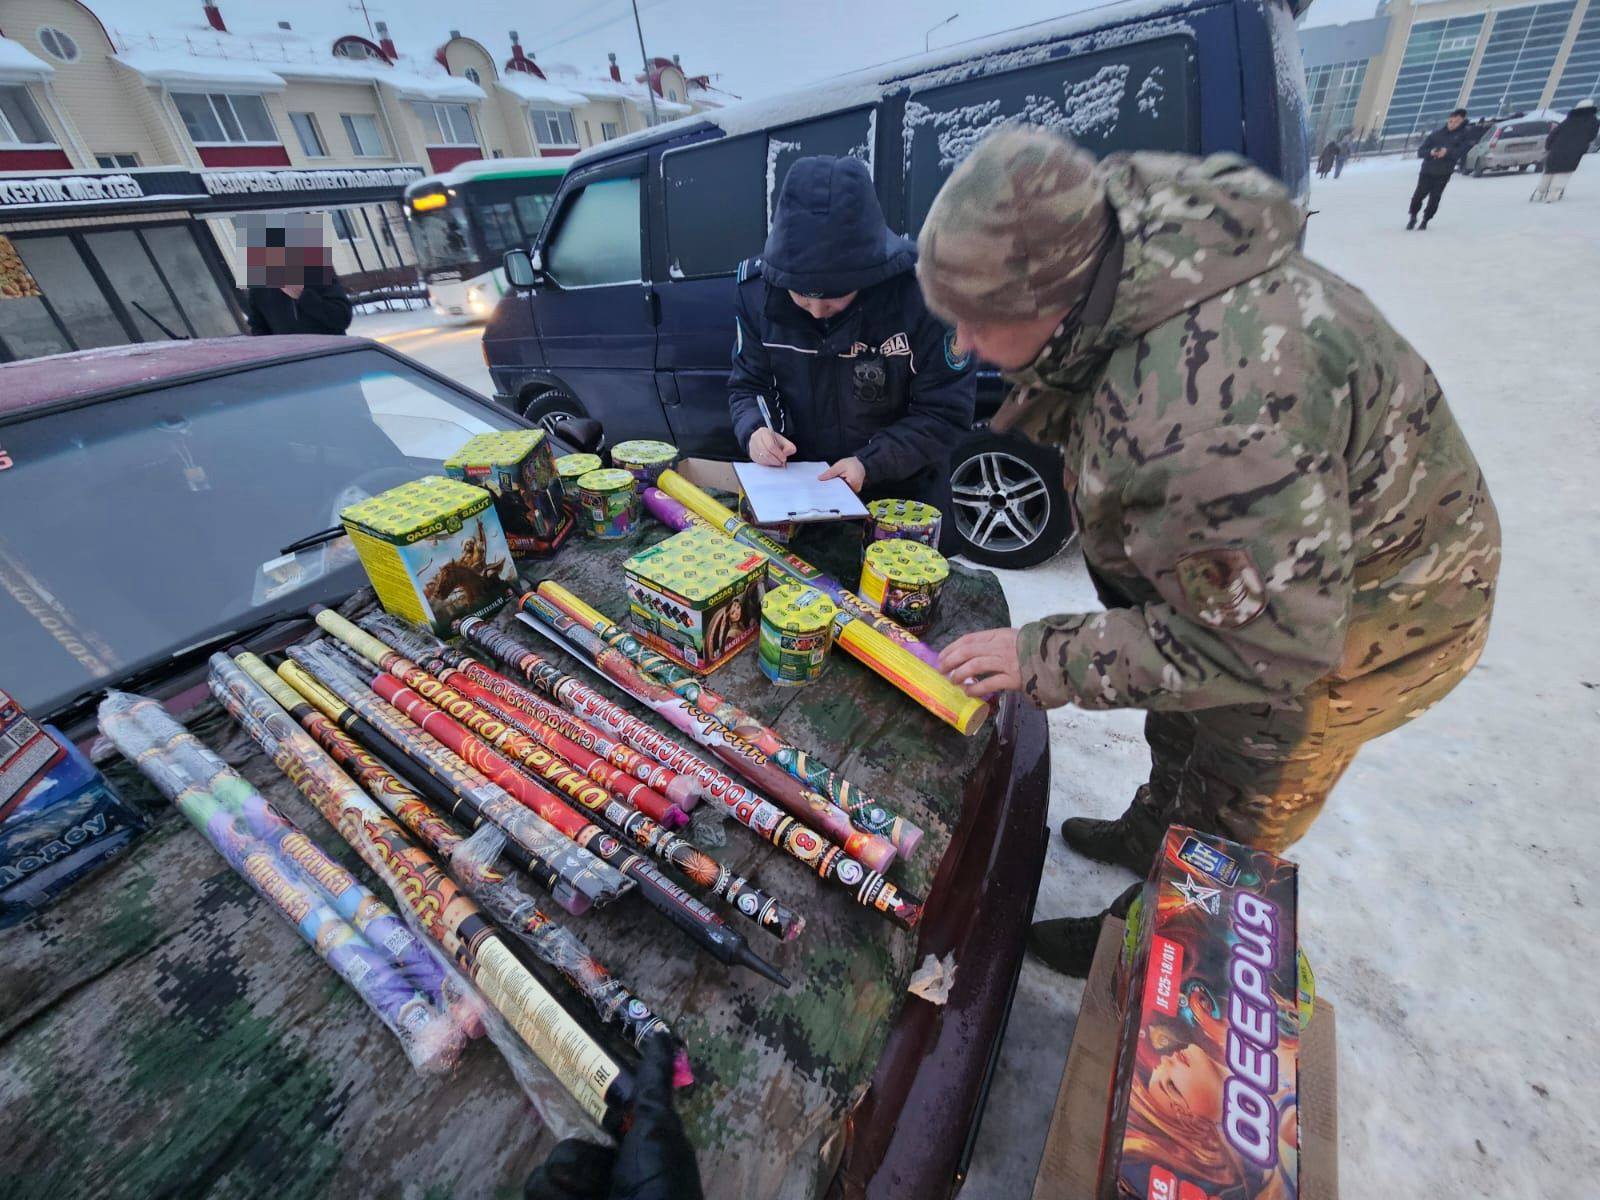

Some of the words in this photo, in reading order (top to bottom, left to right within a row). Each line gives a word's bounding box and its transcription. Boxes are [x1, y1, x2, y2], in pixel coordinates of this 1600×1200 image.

[467, 666, 506, 697] ОГНЯ
[507, 689, 597, 751] СИМФОНИЯ
[524, 750, 611, 811] РУНО
[795, 832, 817, 852] 8
